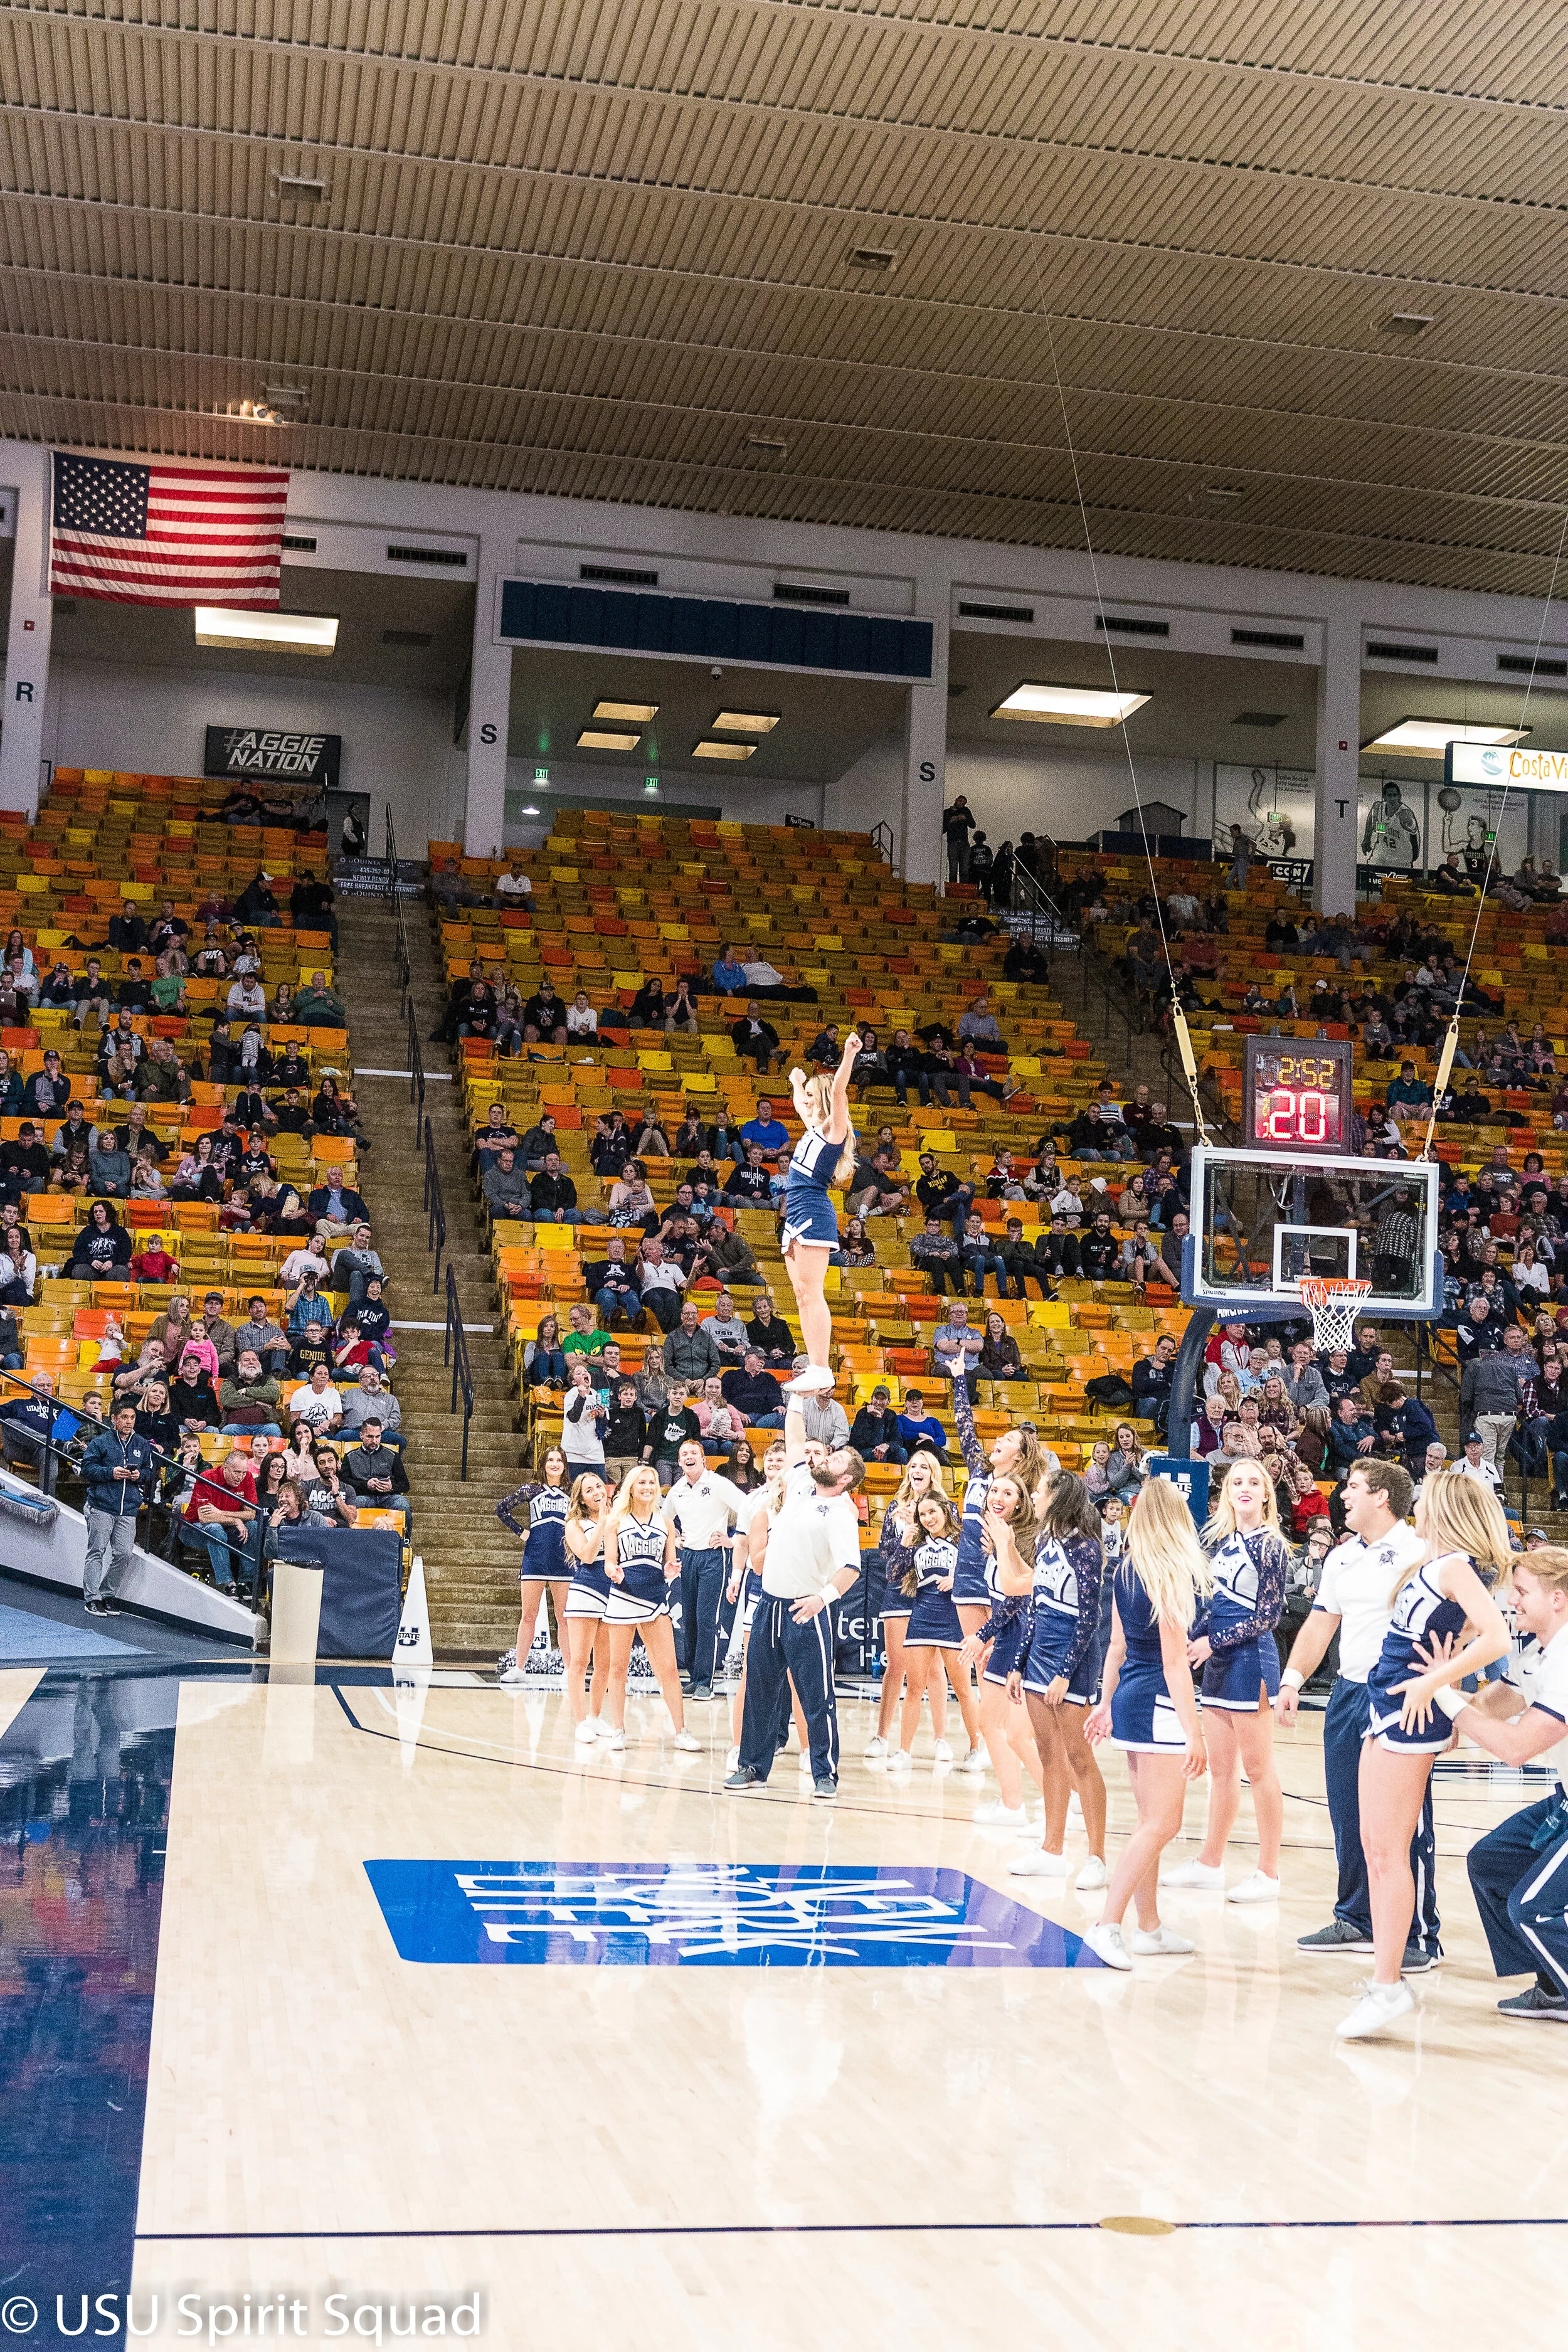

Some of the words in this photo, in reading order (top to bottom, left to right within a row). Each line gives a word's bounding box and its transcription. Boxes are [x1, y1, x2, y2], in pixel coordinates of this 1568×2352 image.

[16, 681, 34, 702] R
[224, 729, 326, 755] #AGGIE
[480, 723, 497, 744] S
[228, 748, 319, 772] NATION
[535, 768, 549, 778] EXIT
[919, 761, 935, 782] S
[645, 777, 659, 787] EXIT
[1335, 799, 1350, 818] T
[1471, 859, 1478, 868] 3
[1278, 1057, 1334, 1088] 2:52
[1268, 1088, 1327, 1142] 20
[300, 1349, 326, 1361] GENIUS
[539, 1496, 569, 1513] AGGIES
[627, 1537, 663, 1557] AGGIES
[917, 1550, 956, 1569] AGGIES
[397, 1632, 420, 1641] STATE
